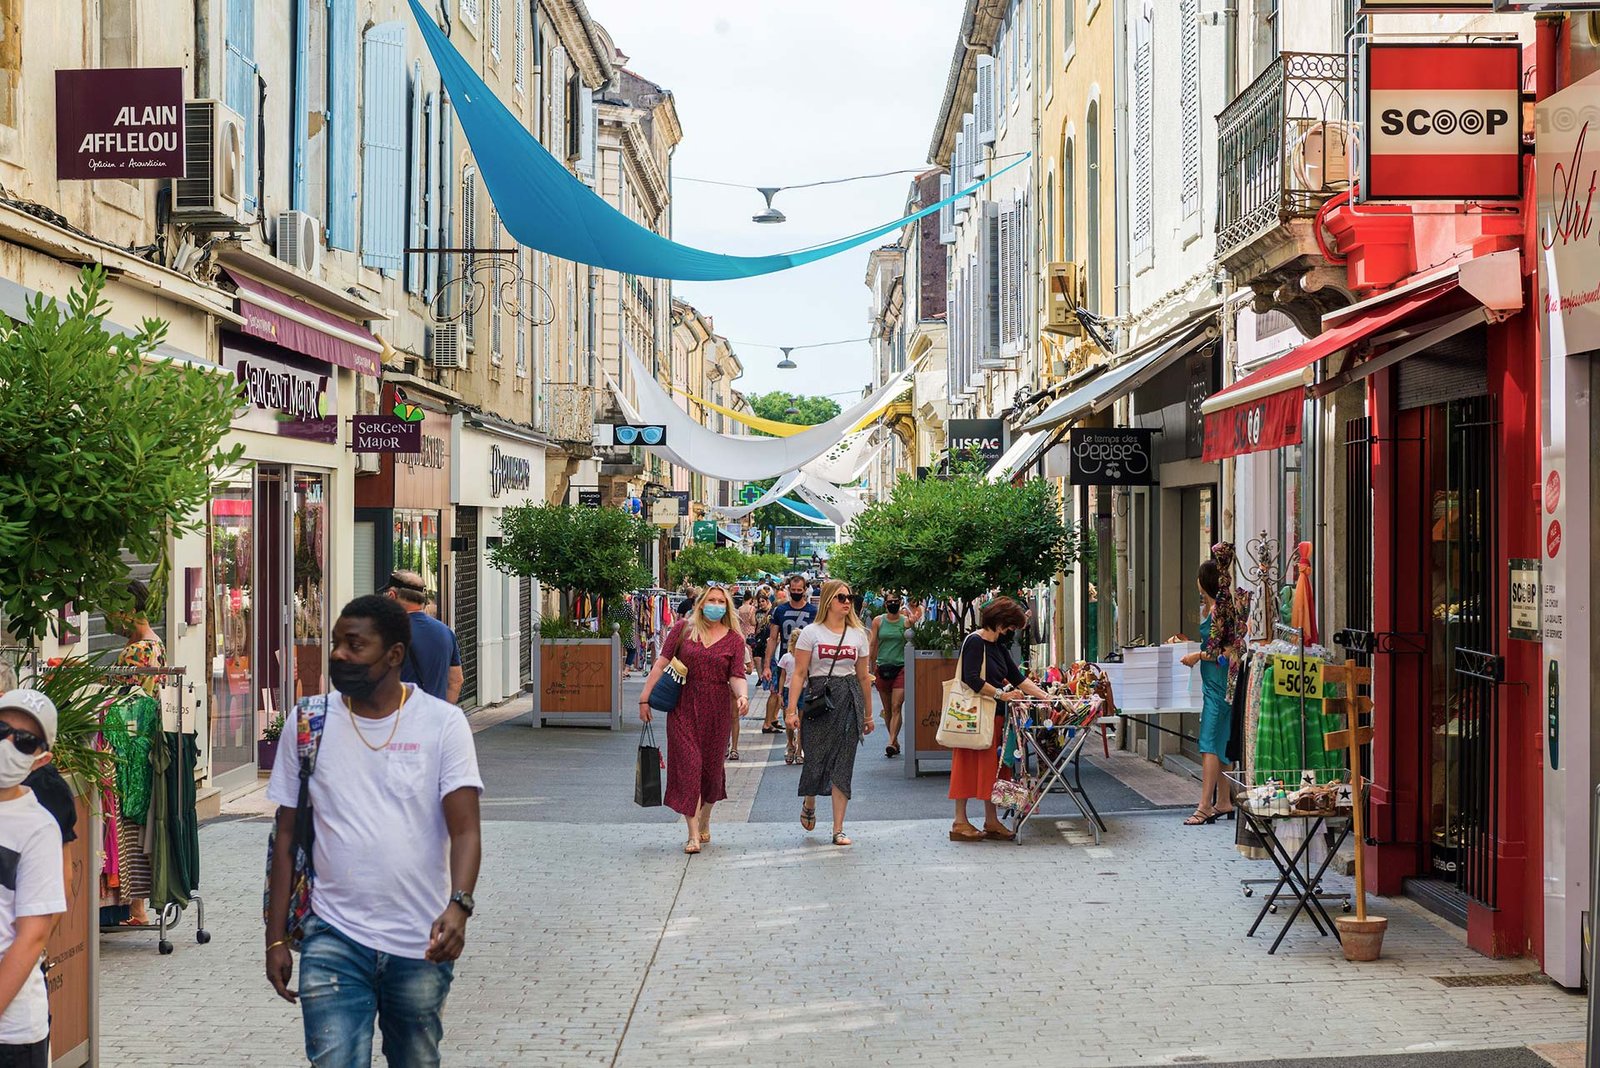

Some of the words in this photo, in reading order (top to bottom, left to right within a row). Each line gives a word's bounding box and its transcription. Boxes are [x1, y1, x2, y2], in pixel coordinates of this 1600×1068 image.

[113, 105, 177, 126] ALAIN
[1381, 108, 1508, 136] SCOOP
[78, 132, 177, 153] AFFLELOU
[88, 158, 116, 171] Opticien
[128, 158, 167, 168] Acousticien
[1542, 120, 1598, 251] Art
[952, 438, 999, 450] LISSAC
[1083, 434, 1093, 443] Le
[1094, 434, 1120, 444] temps
[1122, 434, 1138, 443] des
[1512, 582, 1536, 604] SCOOP
[1280, 659, 1308, 672] TOUT
[1309, 662, 1318, 673] A
[1278, 673, 1317, 695] -50%
